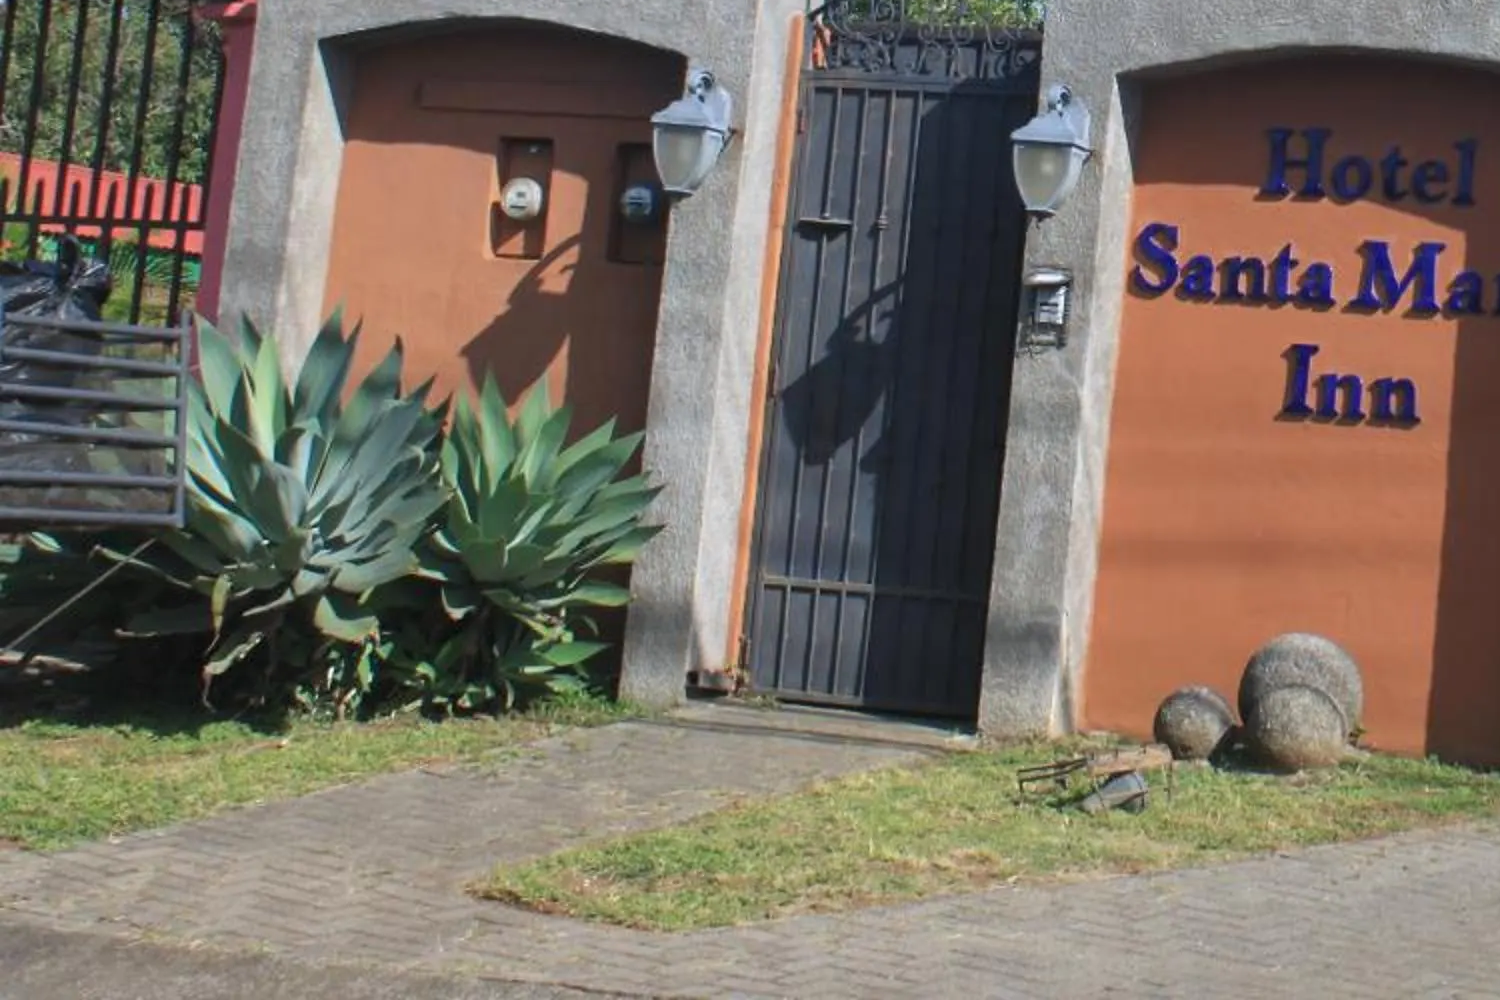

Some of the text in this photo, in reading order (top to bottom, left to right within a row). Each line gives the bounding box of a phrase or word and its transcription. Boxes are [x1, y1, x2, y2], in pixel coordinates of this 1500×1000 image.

[1254, 126, 1480, 207] Hotel
[1128, 222, 1335, 312] Santa
[1274, 342, 1421, 430] Inn
